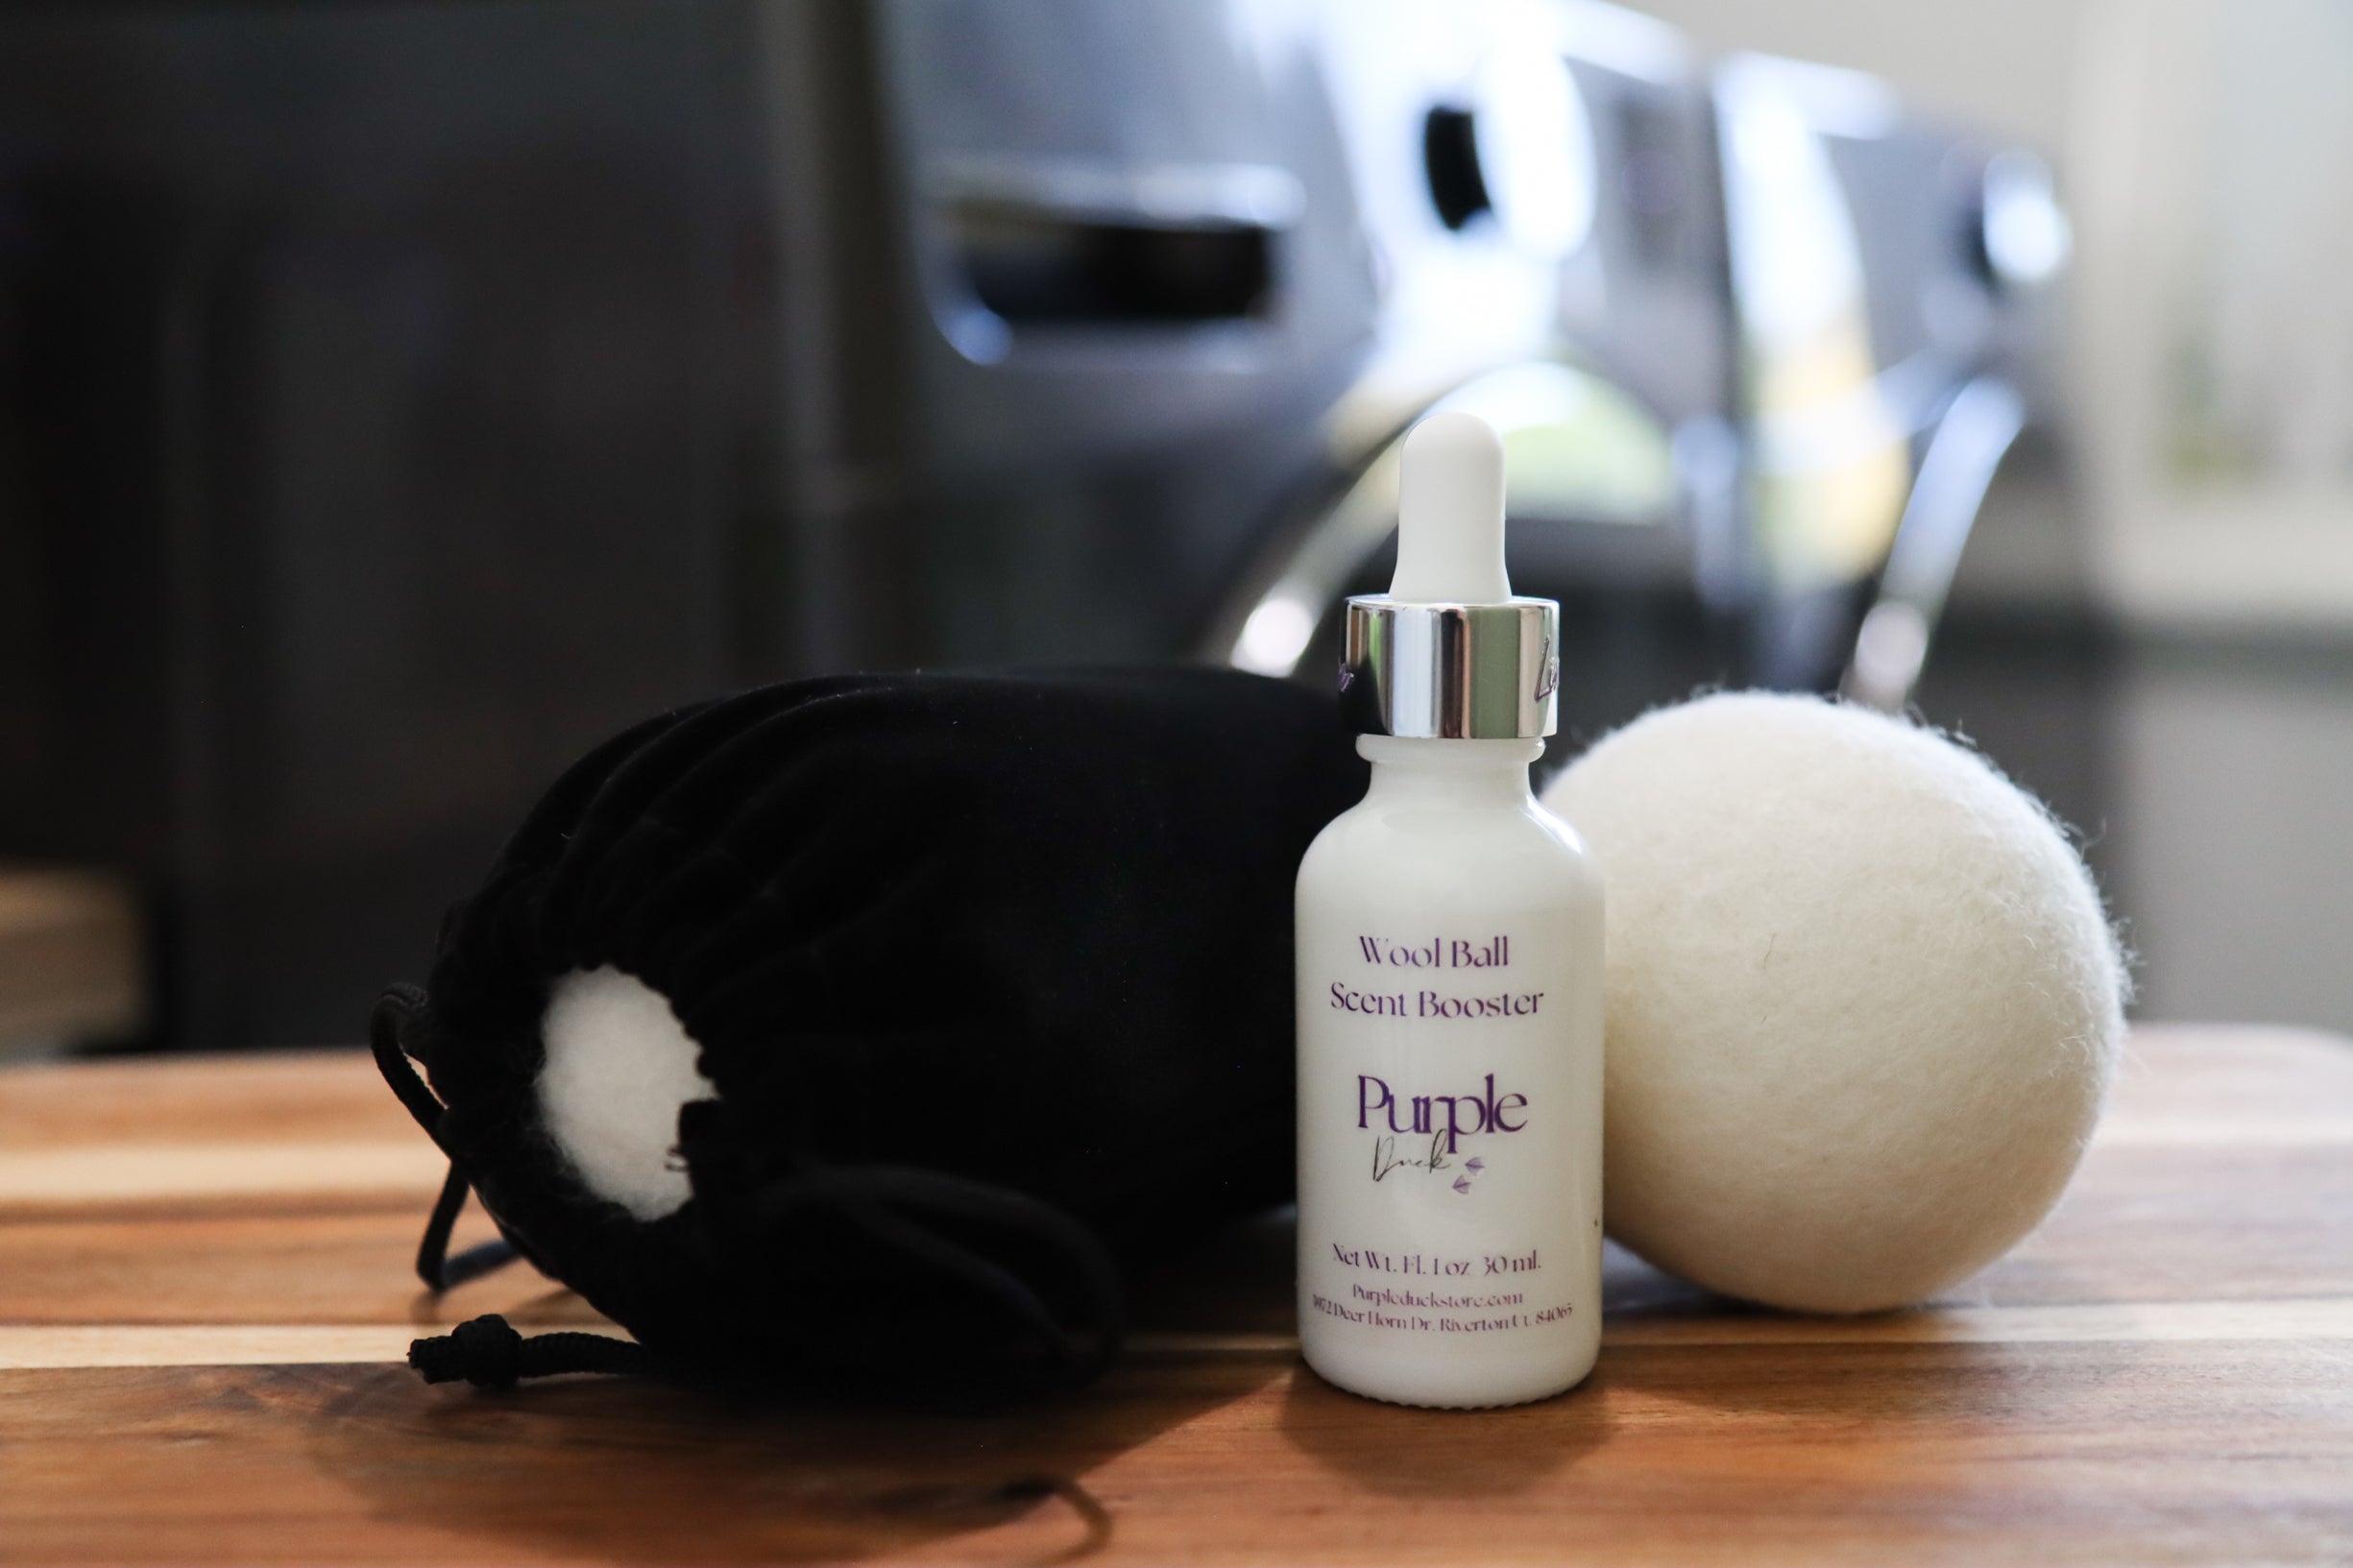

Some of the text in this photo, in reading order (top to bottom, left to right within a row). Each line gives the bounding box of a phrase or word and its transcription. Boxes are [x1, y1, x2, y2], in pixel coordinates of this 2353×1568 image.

[1359, 934, 1509, 968] Wool Ball
[1330, 981, 1544, 1019] Scent Booster
[1357, 1073, 1528, 1154] Purple
[1333, 1242, 1360, 1267] Net
[1444, 1262, 1470, 1276] oz
[1483, 1255, 1508, 1276] 30
[1352, 1283, 1524, 1308] Purpleduckstore.com
[1334, 1302, 1365, 1323] Deer
[1440, 1317, 1509, 1332] Riverton
